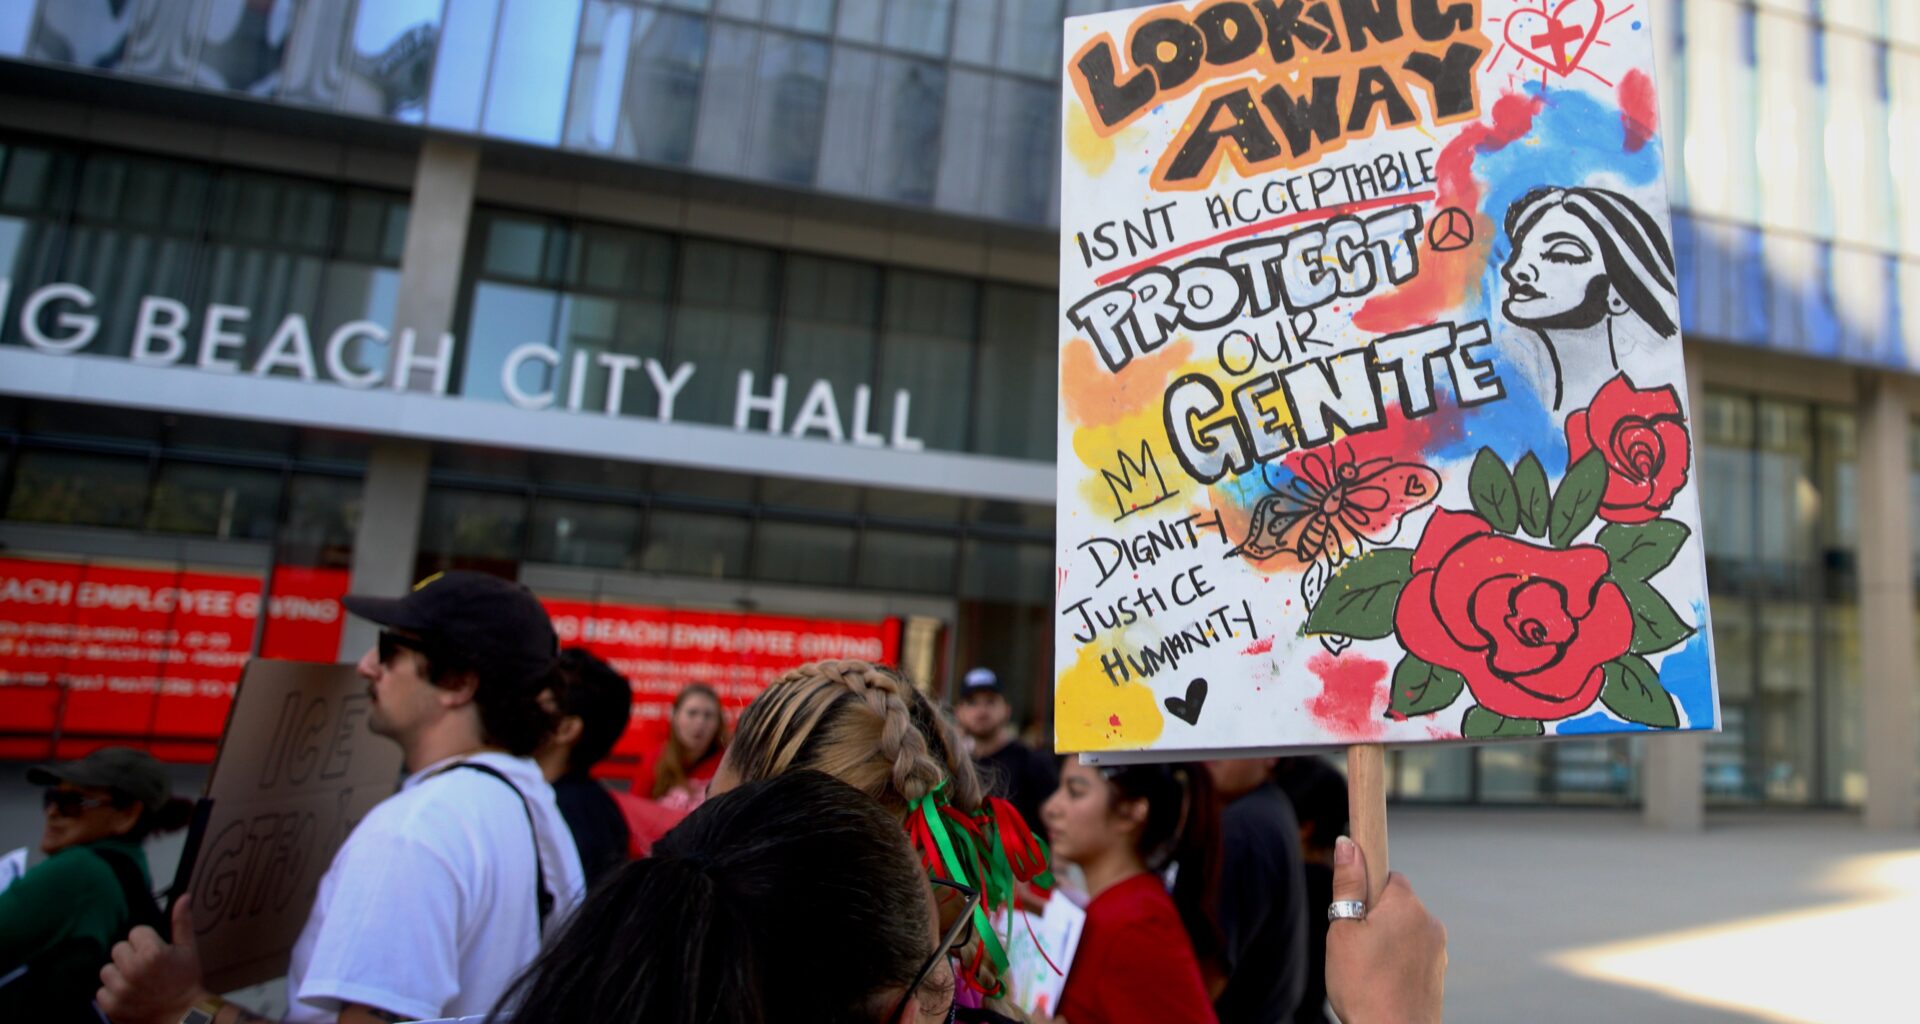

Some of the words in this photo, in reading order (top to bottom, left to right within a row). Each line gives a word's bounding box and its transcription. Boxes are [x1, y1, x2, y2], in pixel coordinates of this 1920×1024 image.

[1076, 0, 1474, 128] LOOKING
[1163, 42, 1483, 182] AWAY
[1077, 202, 1179, 268] ISNT
[1206, 148, 1439, 229] ACCEPTABLE
[1067, 204, 1424, 373] PROTECT
[1217, 310, 1335, 376] OUR
[0, 277, 98, 355] G
[130, 295, 456, 396] BEACH
[501, 341, 697, 424] CITY
[733, 369, 925, 452] HALL
[1163, 319, 1506, 485] GENTE
[76, 582, 235, 618] EMPLOYEE
[1077, 509, 1229, 588] DIGNITY
[581, 616, 670, 648] BEACH
[672, 621, 797, 659] EMPLOYEE
[797, 631, 883, 662] GIVING
[1101, 599, 1258, 687] HUMANITY
[258, 690, 370, 790] ICE
